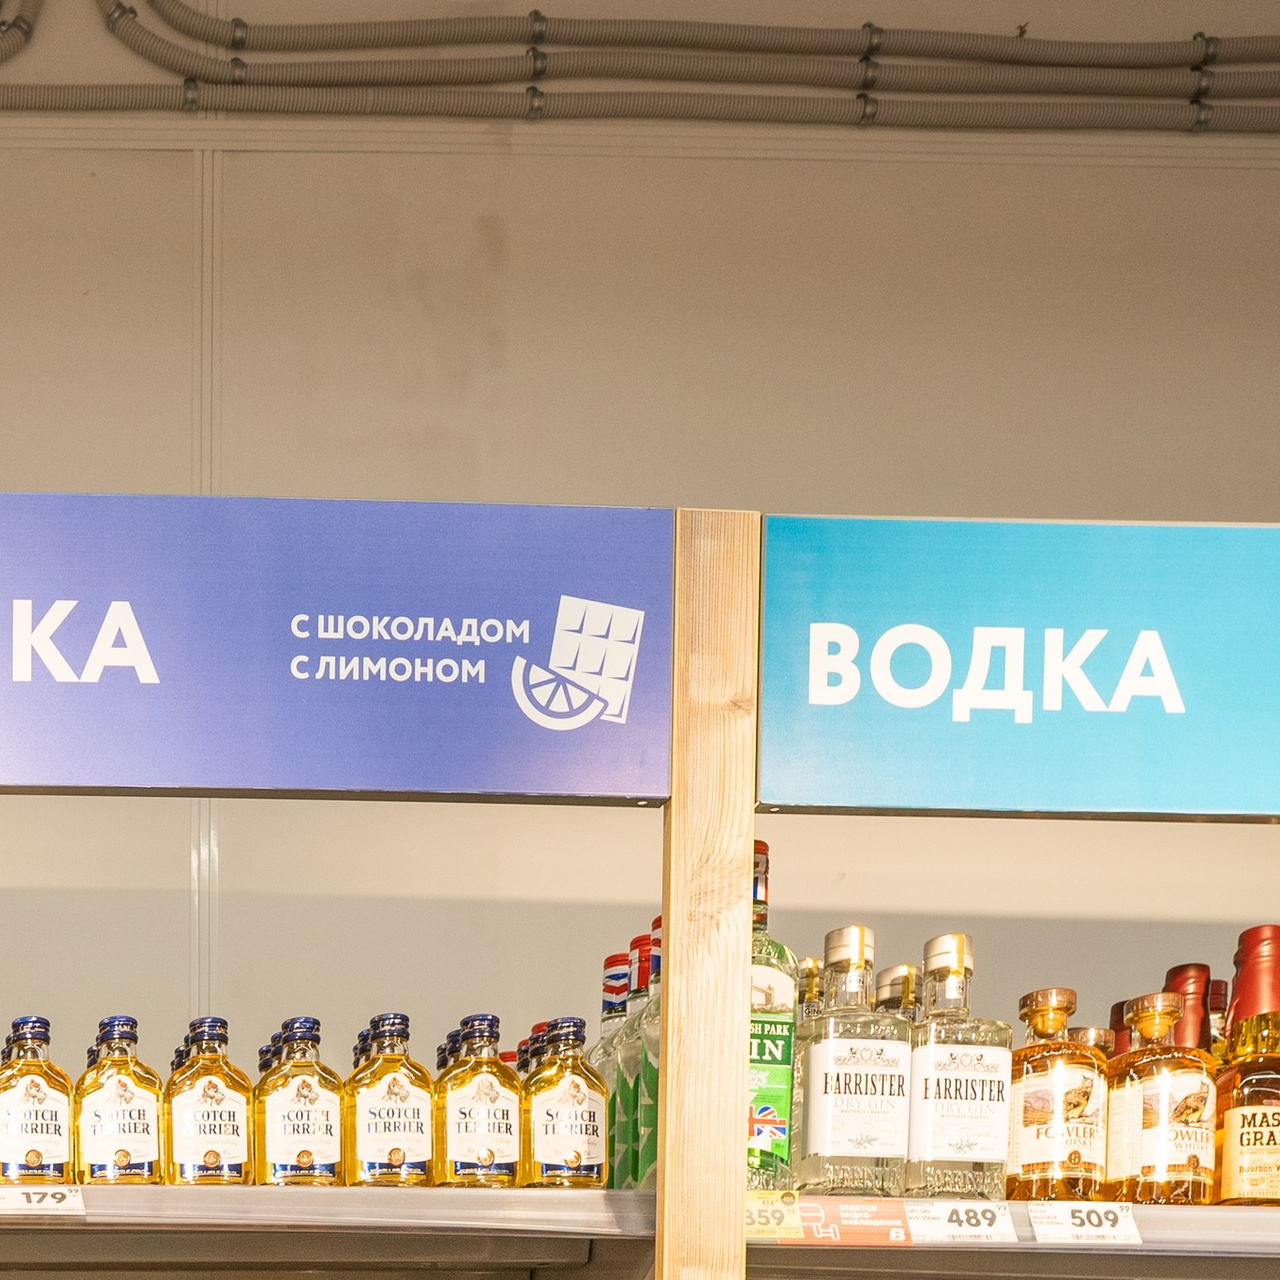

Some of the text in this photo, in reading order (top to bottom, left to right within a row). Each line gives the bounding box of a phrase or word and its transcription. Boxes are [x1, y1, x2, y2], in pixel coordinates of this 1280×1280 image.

[290, 613, 531, 650] С ШОКОЛАДОМ
[290, 655, 487, 686] С ЛИМОНОМ
[808, 624, 1184, 725] ВОДКА
[764, 1024, 789, 1037] PARK
[21, 1191, 66, 1205] 179
[947, 1208, 997, 1227] 489
[1070, 1209, 1119, 1227] 509
